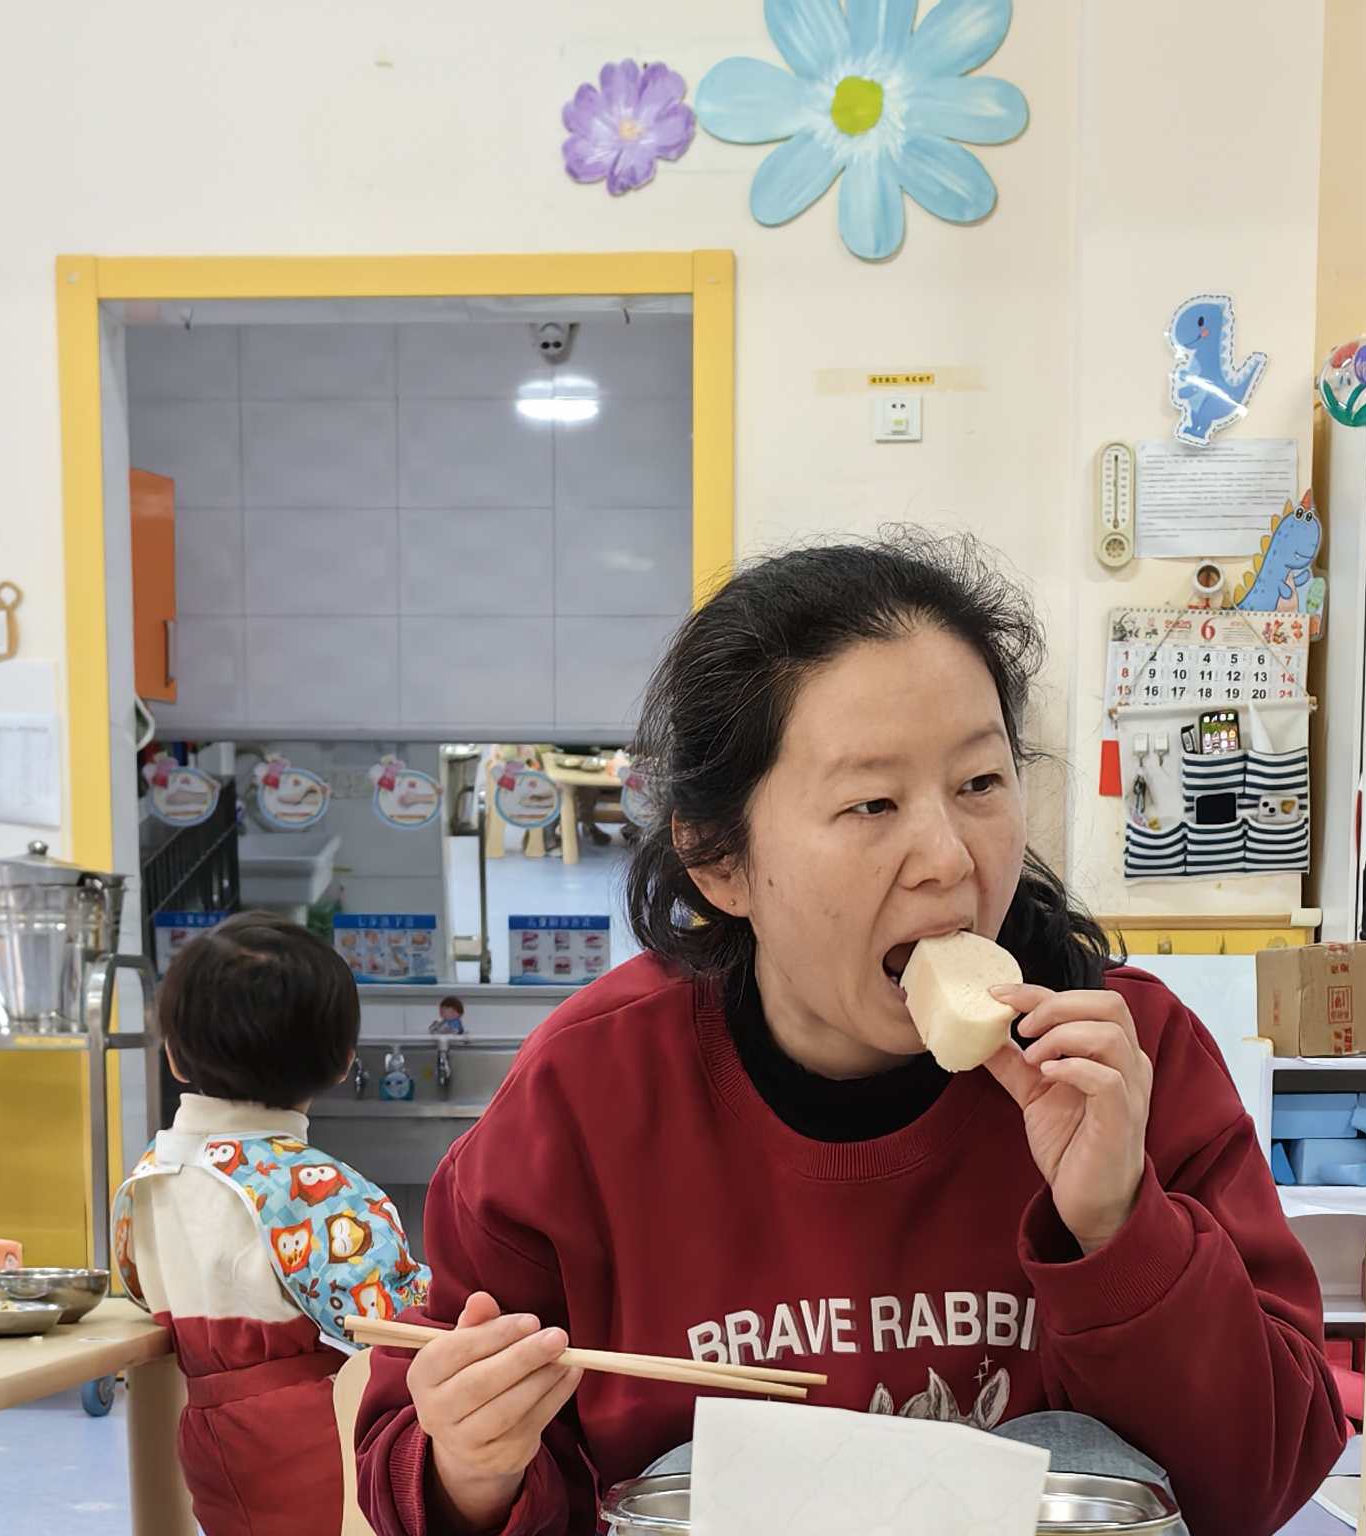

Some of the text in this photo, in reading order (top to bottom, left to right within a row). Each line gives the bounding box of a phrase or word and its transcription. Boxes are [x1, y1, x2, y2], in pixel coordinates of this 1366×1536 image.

[1200, 617, 1216, 641] 6
[1149, 651, 1157, 662] 2
[1176, 652, 1184, 663] 3
[1202, 653, 1211, 664] 4
[1230, 653, 1238, 664] 5
[1257, 654, 1265, 665] 6
[1121, 668, 1295, 684] 8 9 10 11 12 13 14
[1144, 685, 1159, 696] 16
[1171, 686, 1186, 697] 17
[1198, 687, 1213, 698] 18
[1225, 688, 1240, 699] 19
[1251, 689, 1267, 699] 20
[686, 1290, 1036, 1366] BRAVE RABBI
